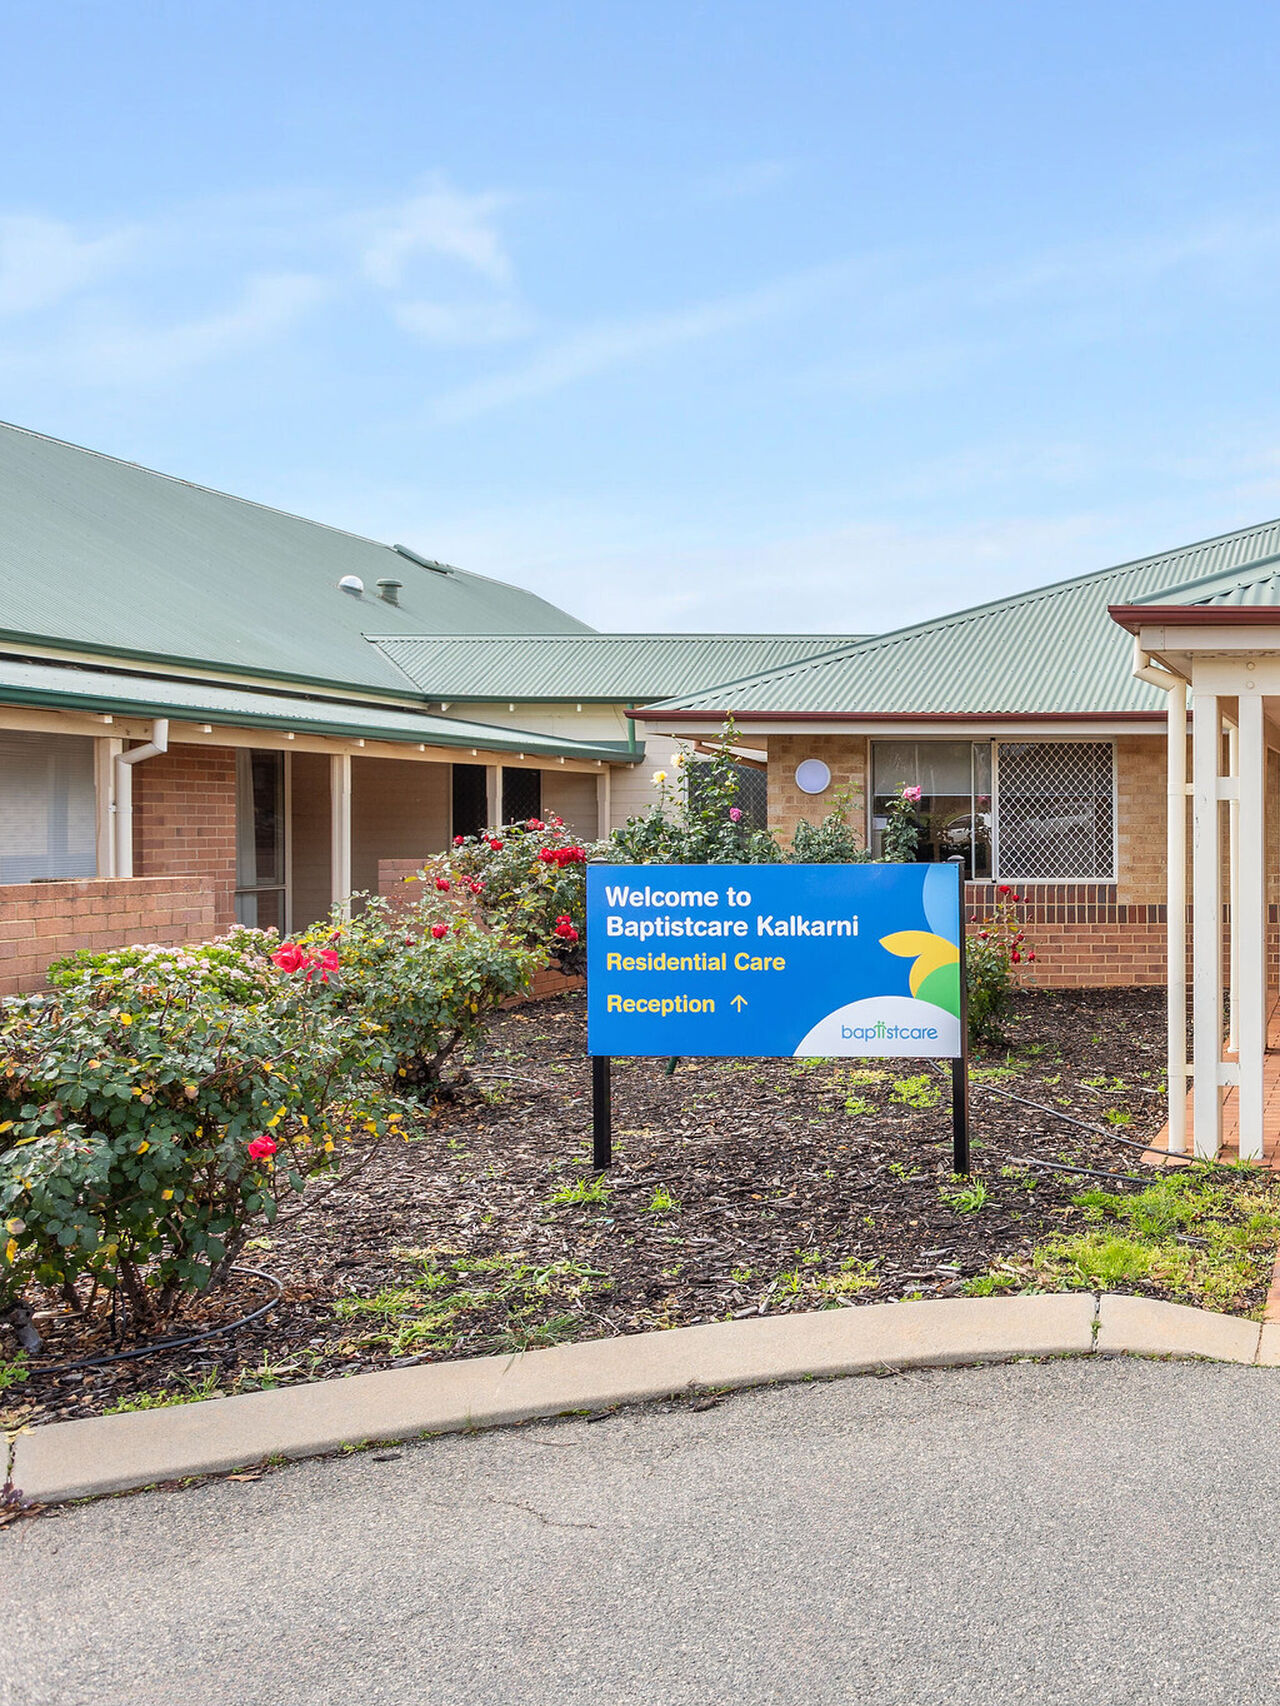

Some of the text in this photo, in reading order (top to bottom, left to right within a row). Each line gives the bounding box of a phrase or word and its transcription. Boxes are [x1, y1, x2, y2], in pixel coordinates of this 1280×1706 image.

[605, 886, 751, 907] Welcome to
[606, 915, 858, 941] Baptistcare Kalkarni
[606, 952, 785, 970] Residential Care
[606, 995, 715, 1016] Reception
[841, 1020, 938, 1042] baptistcare
